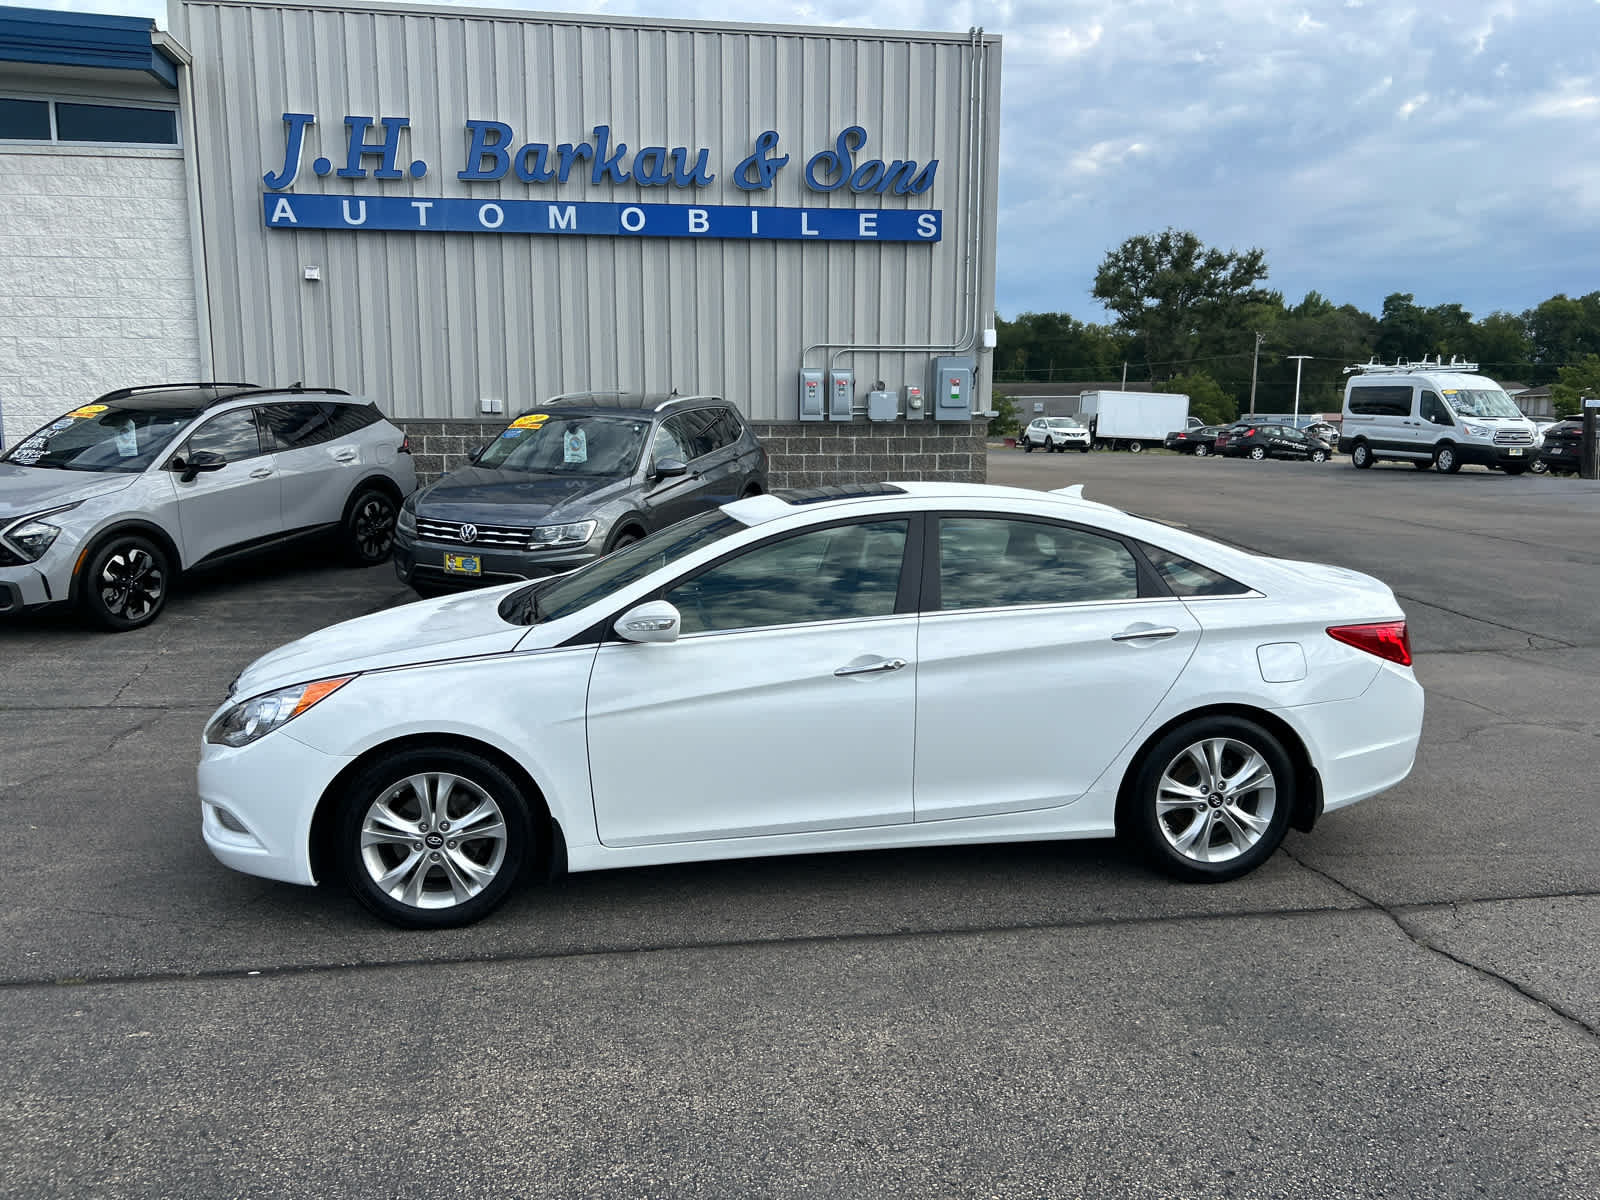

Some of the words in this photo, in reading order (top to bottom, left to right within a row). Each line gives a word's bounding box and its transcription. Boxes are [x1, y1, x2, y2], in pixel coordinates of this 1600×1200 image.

[263, 113, 428, 190] J.H.
[457, 119, 714, 188] Barkau
[733, 130, 789, 190] &
[805, 125, 940, 195] Sons
[271, 197, 938, 238] AUTOMOBILES
